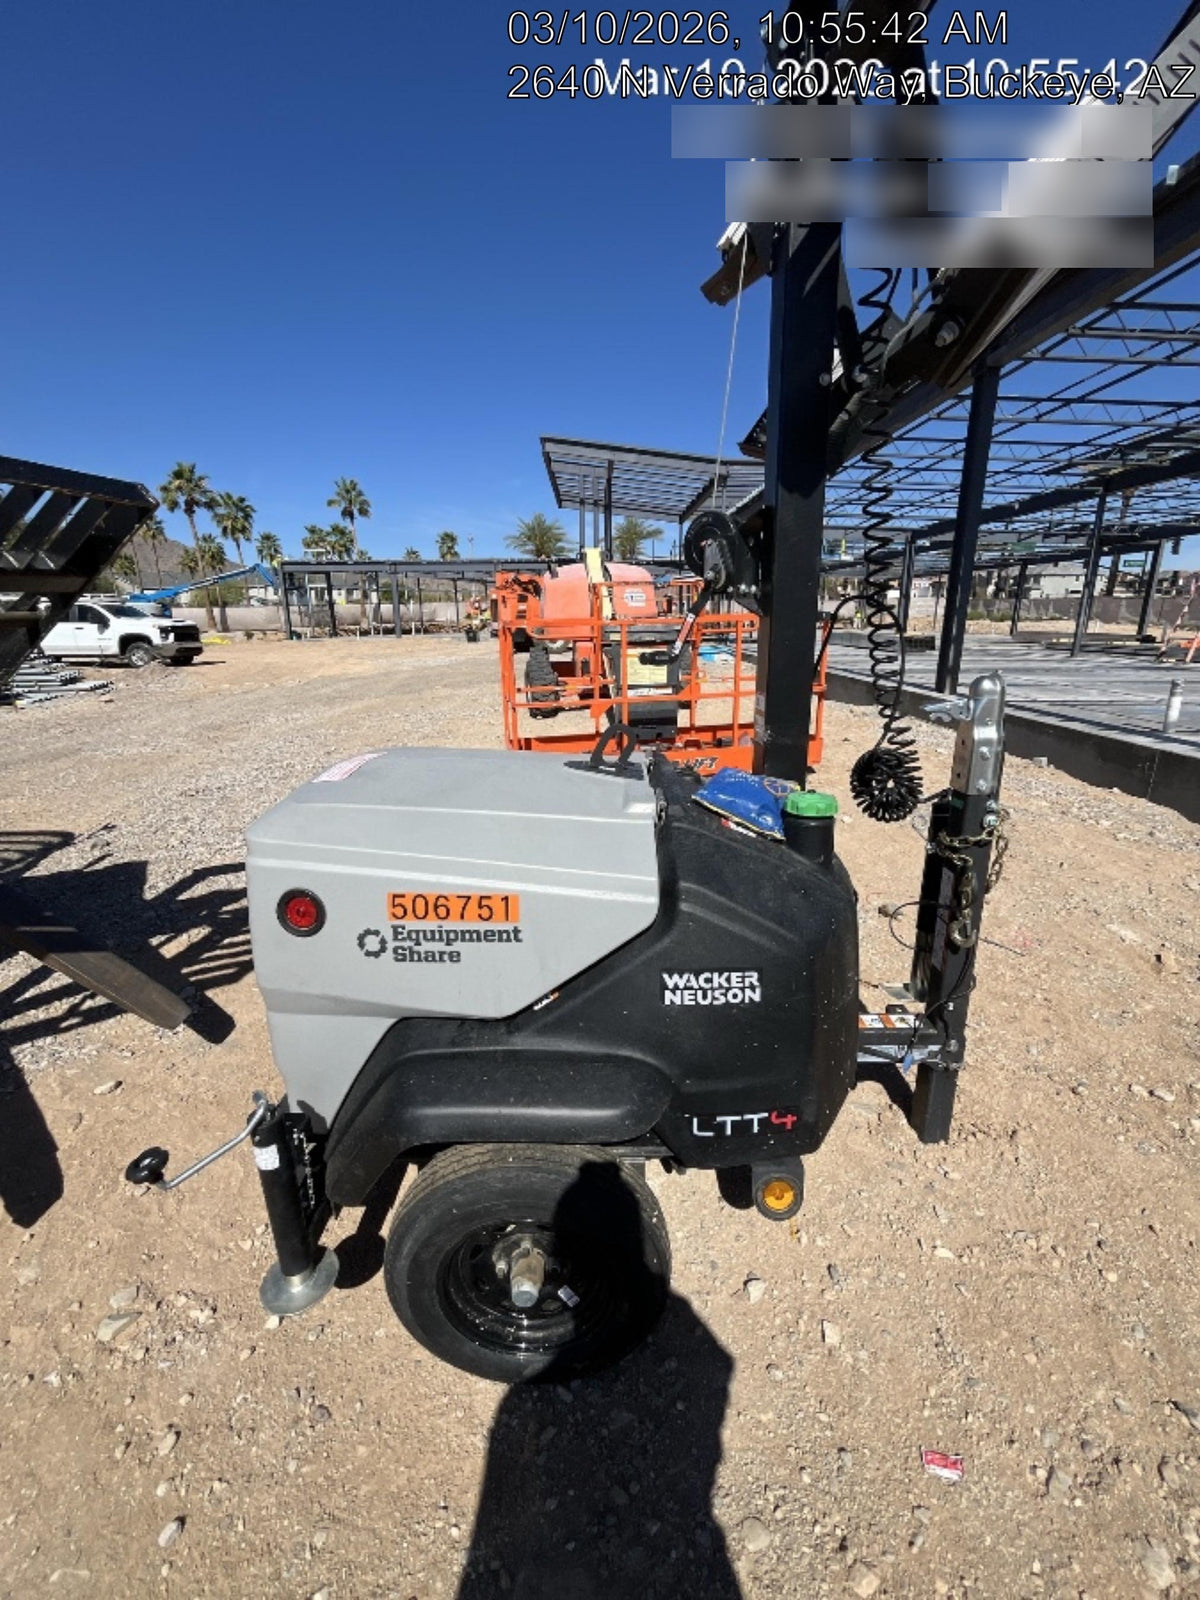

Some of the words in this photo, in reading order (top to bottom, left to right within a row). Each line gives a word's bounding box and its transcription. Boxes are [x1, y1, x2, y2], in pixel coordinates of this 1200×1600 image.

[391, 893, 511, 922] 506751
[391, 925, 523, 946] Equipment
[392, 946, 462, 963] Share
[662, 970, 761, 990] WACKER
[664, 986, 762, 1006] NEUSON
